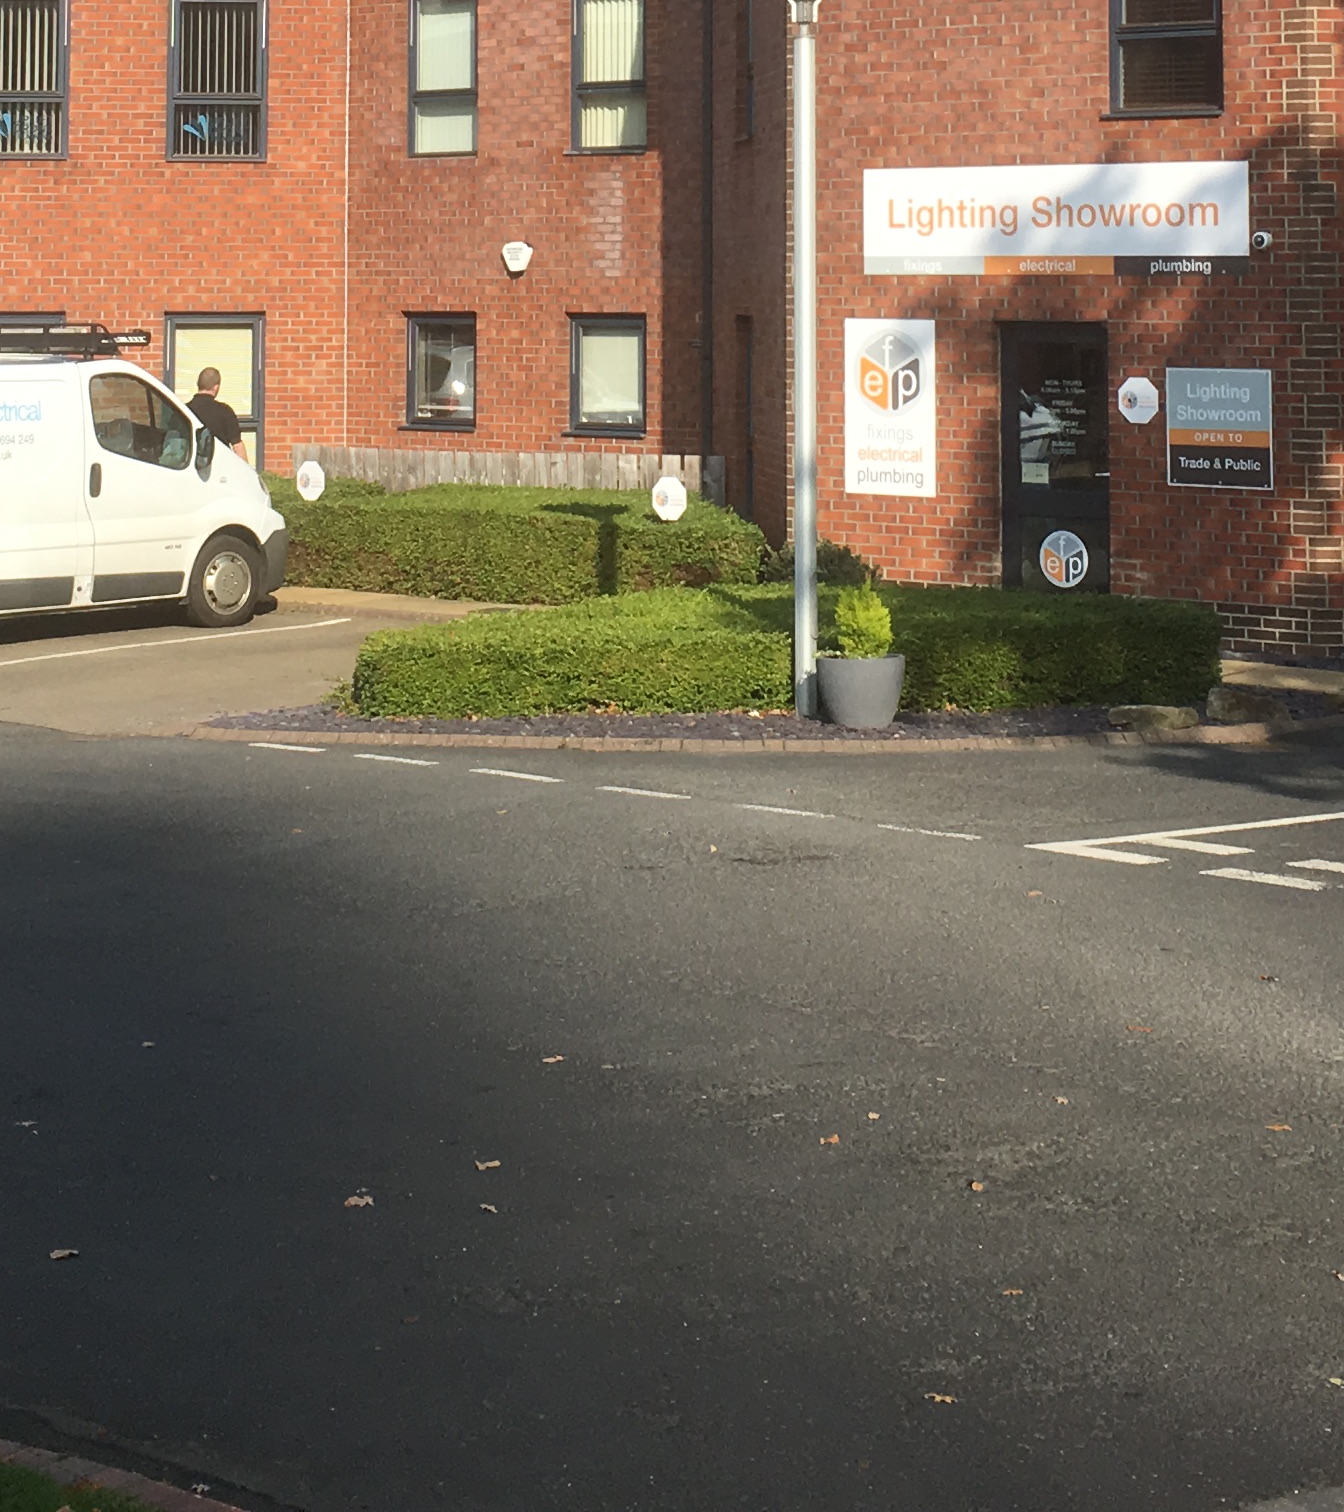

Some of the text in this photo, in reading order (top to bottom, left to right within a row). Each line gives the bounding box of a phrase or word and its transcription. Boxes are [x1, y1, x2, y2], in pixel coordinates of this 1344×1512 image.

[888, 196, 1219, 236] Lighting Showroom
[903, 258, 1212, 274] fixings electrical plumbing
[1186, 382, 1251, 403] Lighting
[1176, 404, 1262, 422] Showroom
[0, 434, 16, 445] 694
[18, 434, 35, 445] 249
[867, 423, 914, 444] fixings
[1194, 432, 1243, 443] OPEN TO
[858, 445, 923, 463] electrical
[1178, 456, 1262, 471] Trade & Public
[857, 467, 924, 489] plumbing
